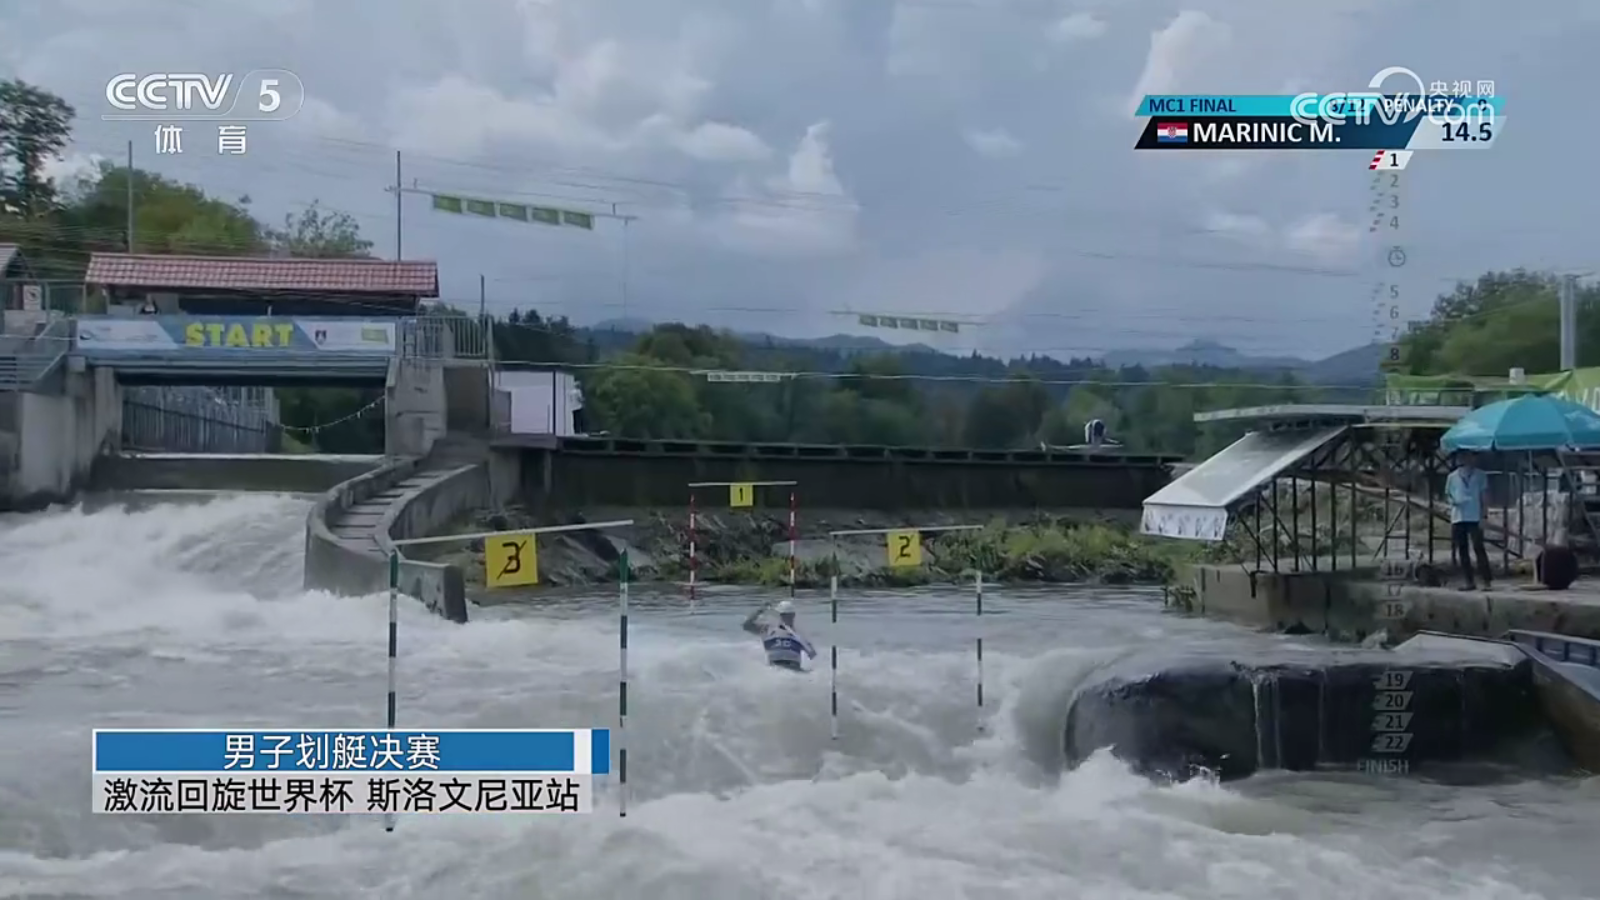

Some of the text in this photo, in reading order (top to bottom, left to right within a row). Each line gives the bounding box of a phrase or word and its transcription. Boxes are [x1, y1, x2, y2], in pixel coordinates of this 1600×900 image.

[185, 322, 295, 348] START
[737, 487, 745, 502] 1
[501, 540, 522, 574] 3
[897, 535, 912, 558] 2
